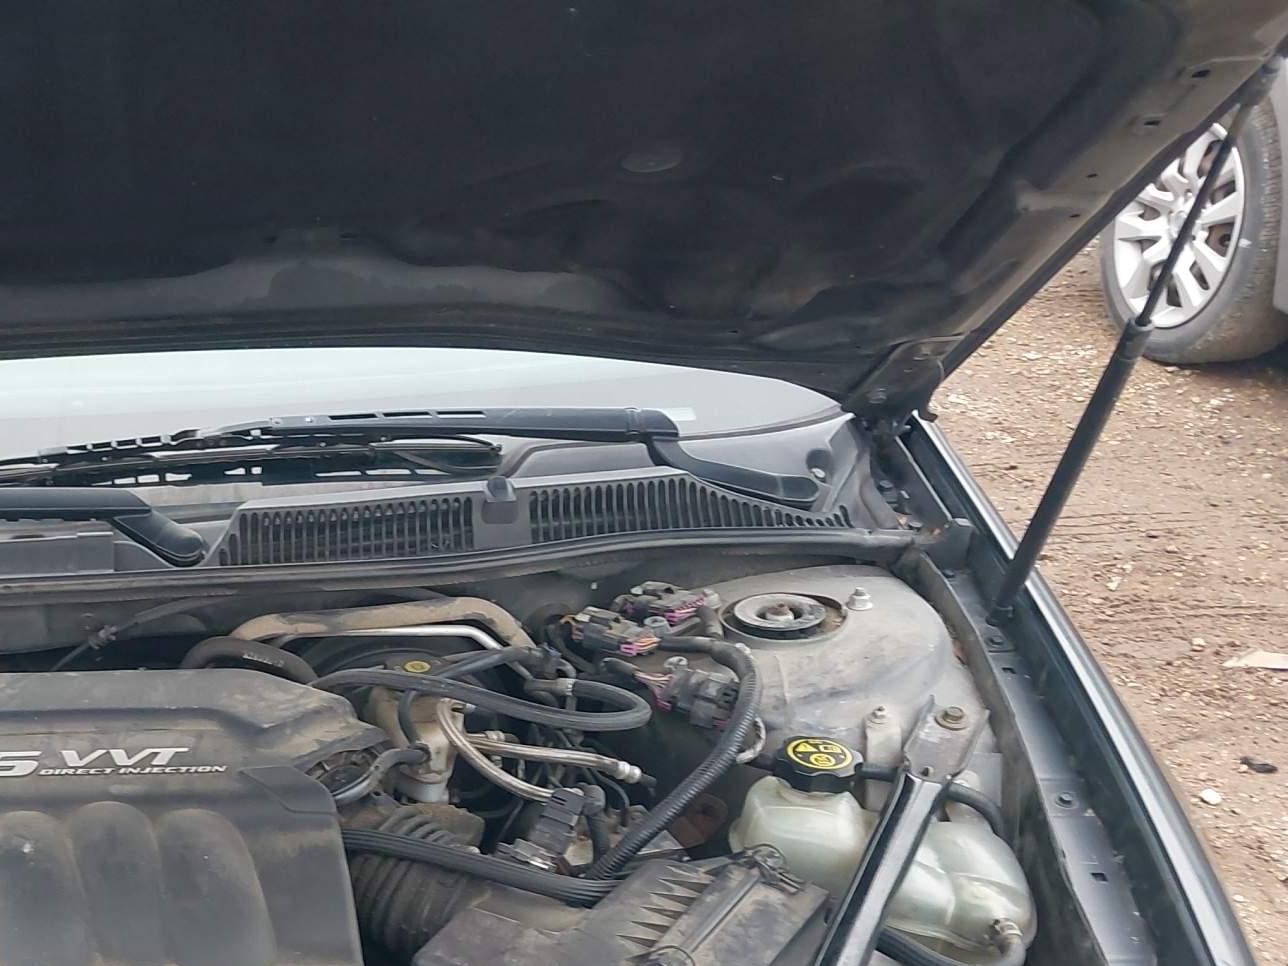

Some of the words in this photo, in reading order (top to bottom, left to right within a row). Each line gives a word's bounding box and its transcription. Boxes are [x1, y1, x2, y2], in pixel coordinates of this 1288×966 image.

[60, 747, 191, 767] VVT
[38, 766, 114, 777] DIRECT
[118, 764, 228, 775] INJECTION
